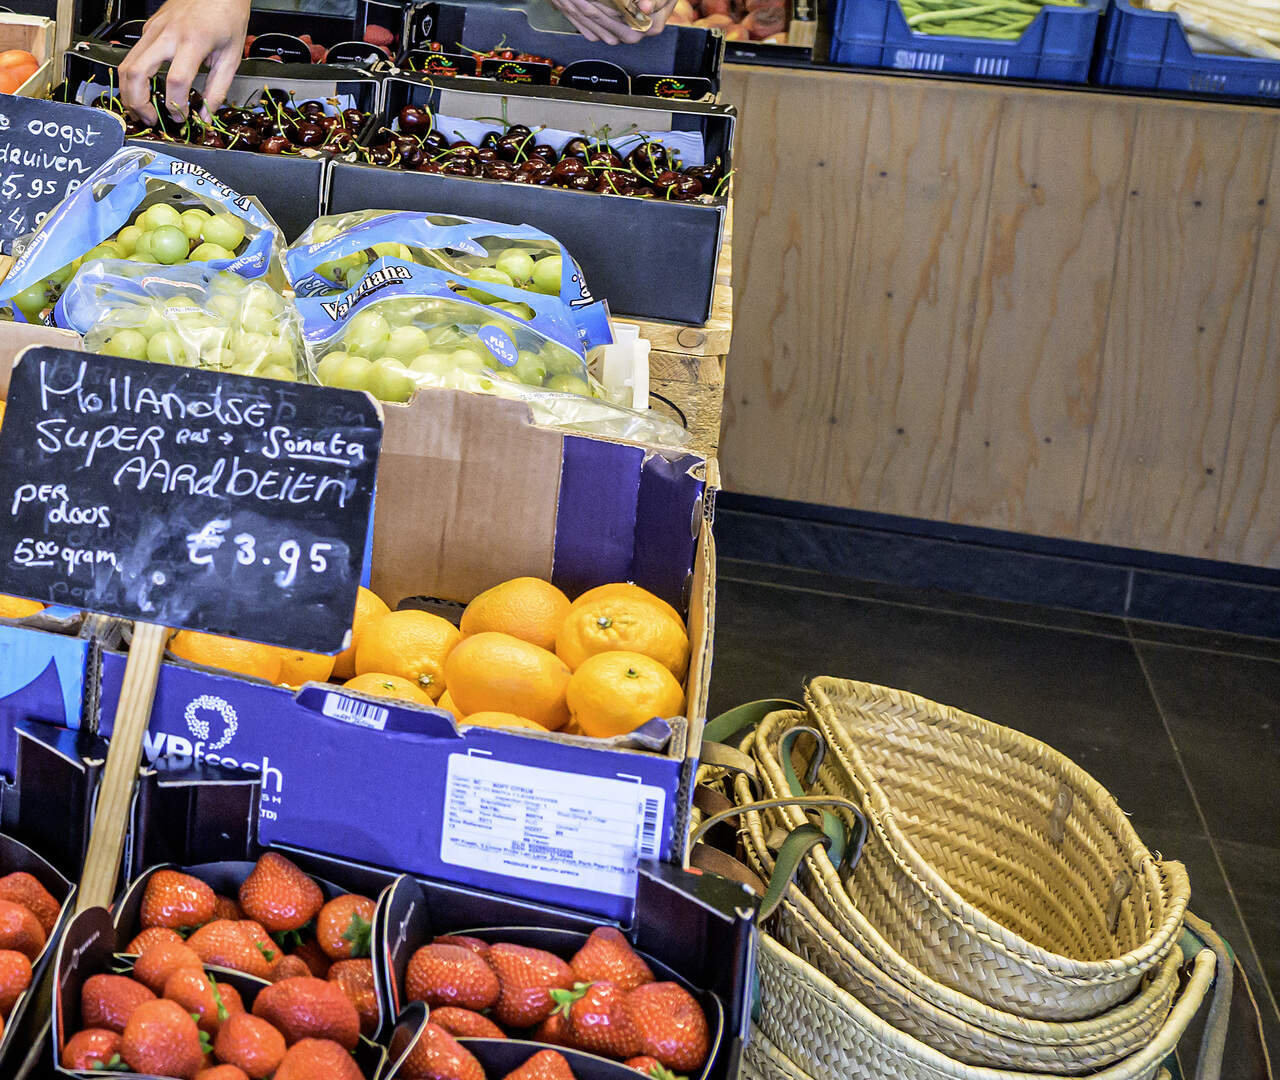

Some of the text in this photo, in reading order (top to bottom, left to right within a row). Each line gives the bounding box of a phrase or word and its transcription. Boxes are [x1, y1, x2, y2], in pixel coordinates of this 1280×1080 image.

[27, 119, 101, 154] oogst
[262, 426, 365, 461] Sonata
[48, 497, 112, 529] doos
[186, 518, 232, 566] €
[234, 532, 333, 588] 3.95
